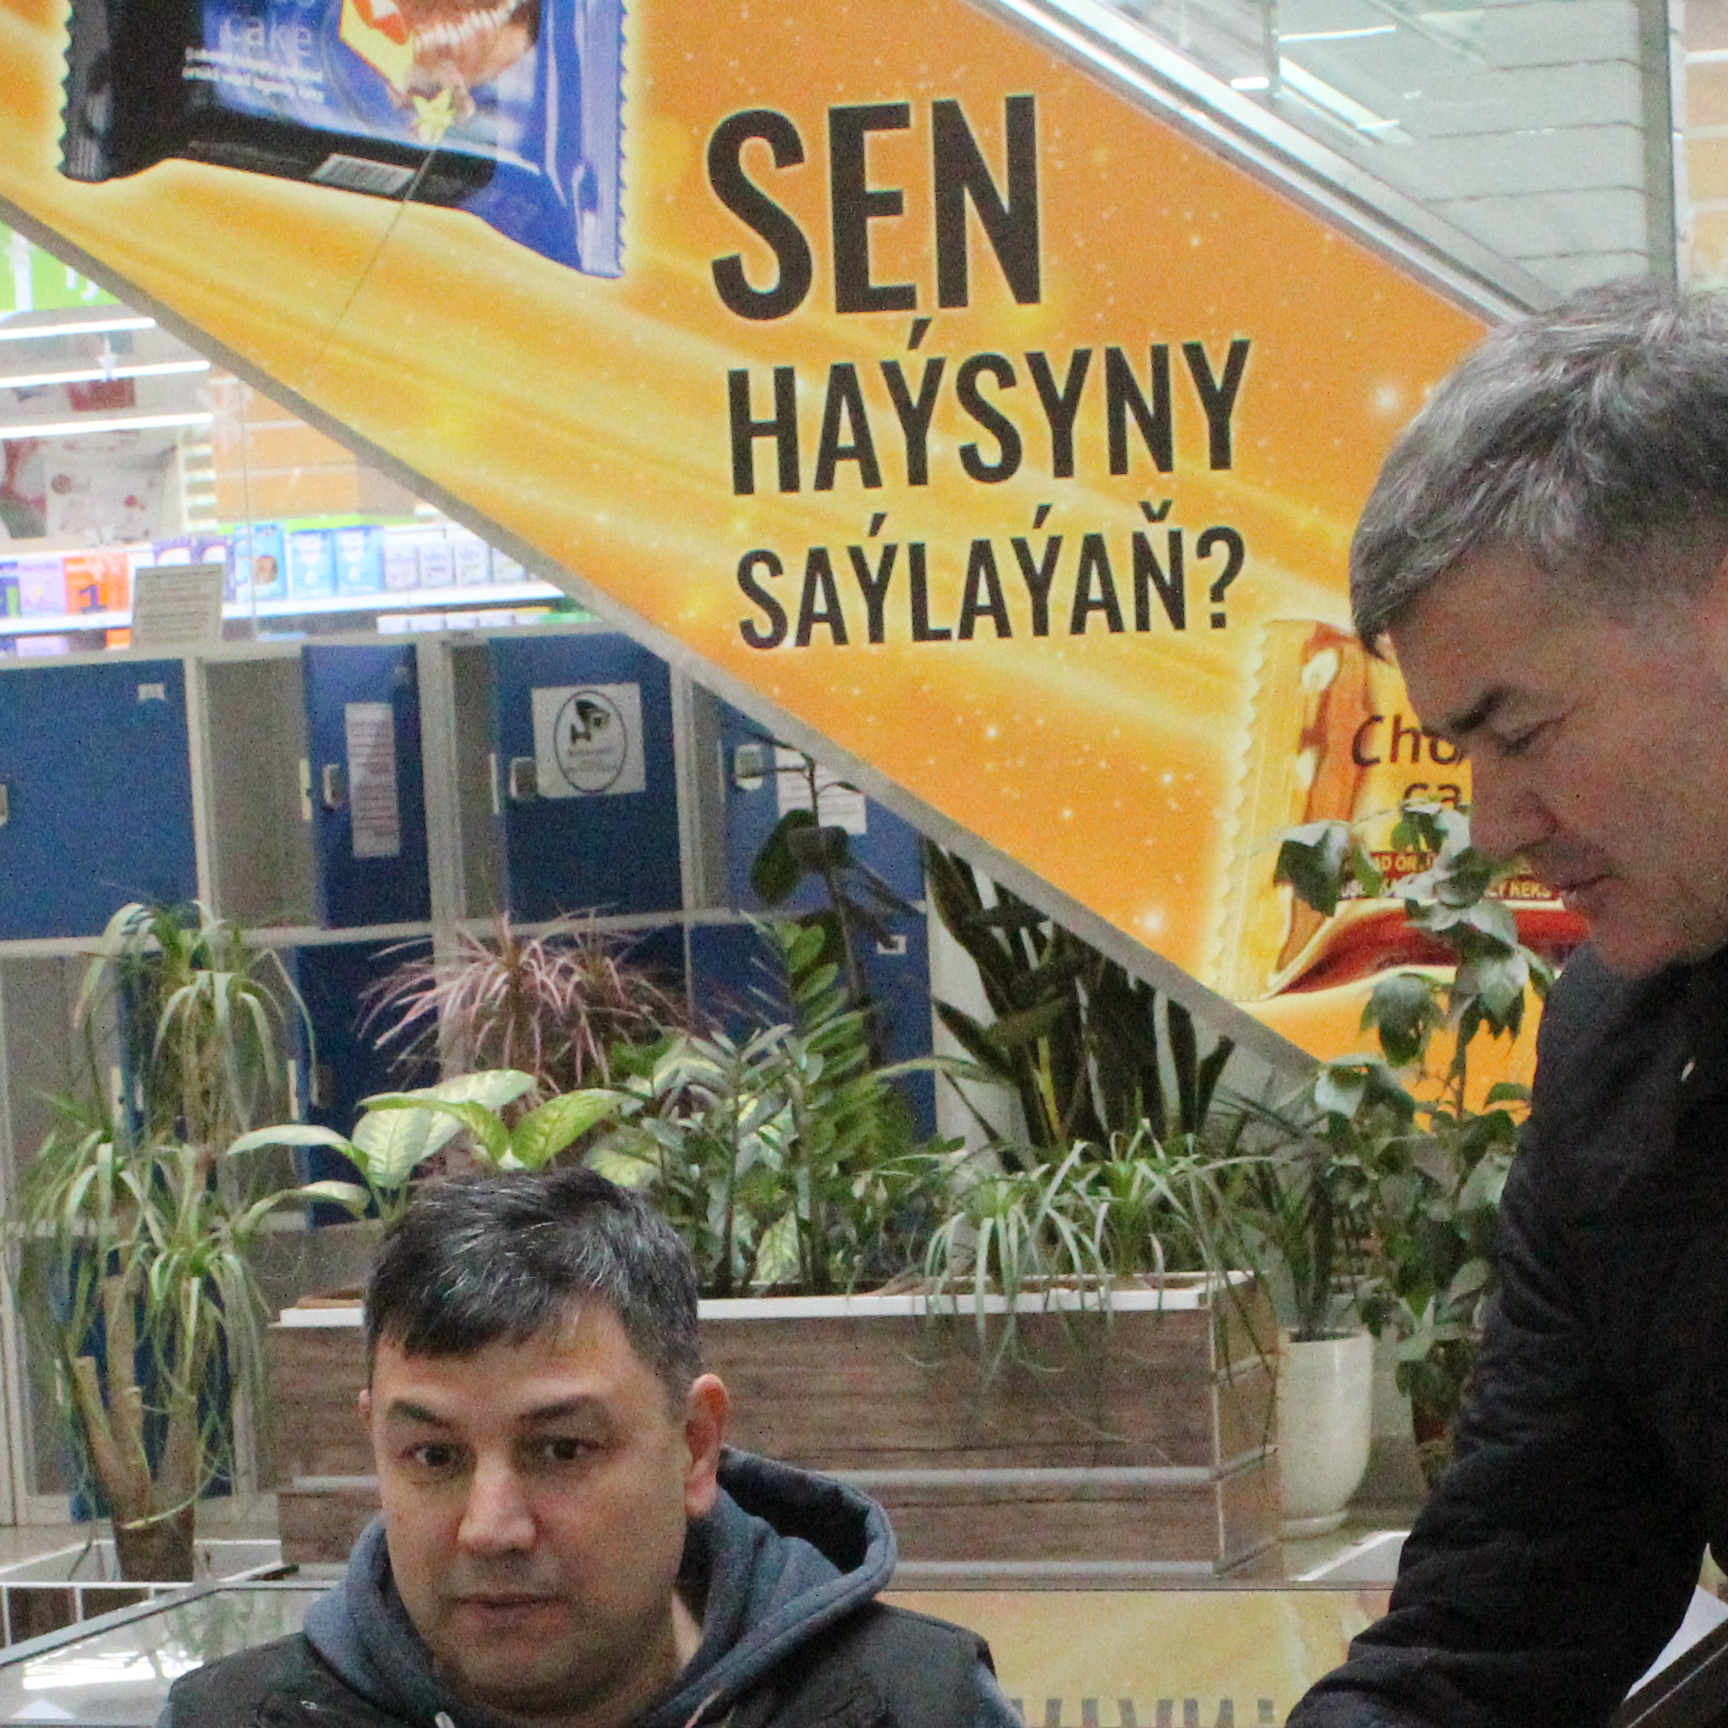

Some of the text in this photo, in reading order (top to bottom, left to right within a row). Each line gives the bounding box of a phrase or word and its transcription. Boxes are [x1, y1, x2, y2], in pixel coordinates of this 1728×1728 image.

[706, 94, 1042, 321] SEN
[727, 317, 1252, 496] HAÝSYNY
[737, 500, 1246, 650] SAÝLAÝAŇ?
[1352, 714, 1464, 767] Cho
